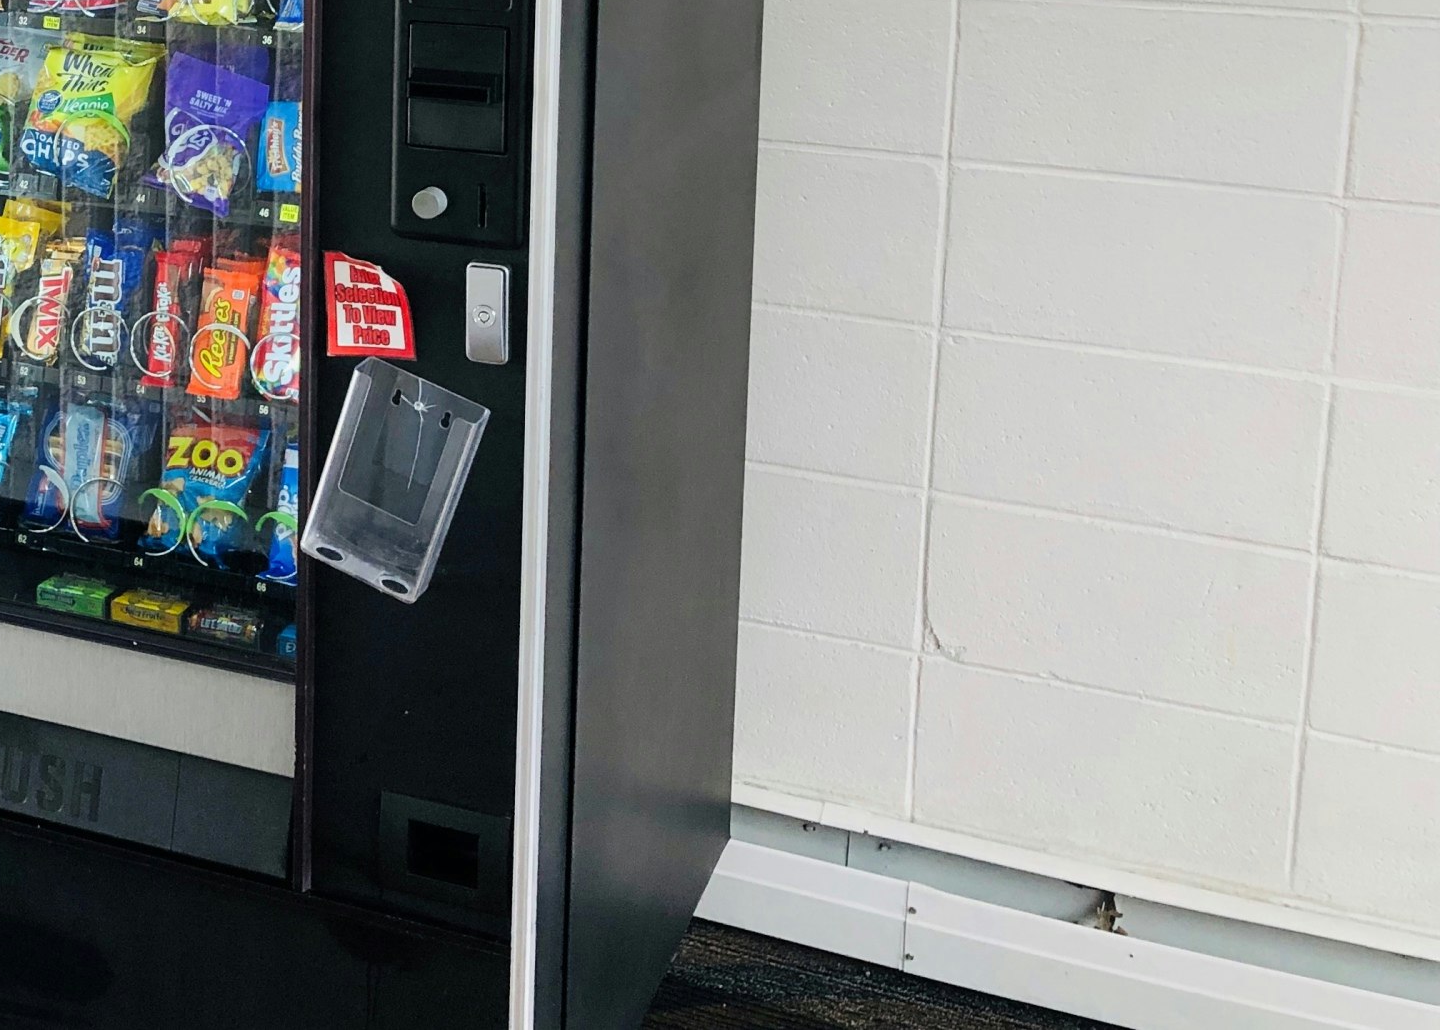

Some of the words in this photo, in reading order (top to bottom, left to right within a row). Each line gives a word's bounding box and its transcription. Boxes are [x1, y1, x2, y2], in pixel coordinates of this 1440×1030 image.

[18, 16, 28, 25] 32
[136, 25, 147, 35] 34
[262, 35, 272, 45] 36
[63, 51, 118, 79] Wheat
[56, 72, 110, 93] Thins
[196, 89, 222, 106] SWEET
[62, 97, 110, 118] Veggie
[189, 97, 213, 111] SALTY
[213, 102, 229, 114] MIX
[35, 131, 80, 150] TOATED
[19, 180, 29, 189] 42
[136, 193, 146, 203] 44
[259, 208, 270, 217] 46
[281, 205, 298, 213] VALUE
[282, 211, 296, 220] ITEM
[335, 283, 401, 307] Selection
[37, 266, 74, 350] TWIX
[342, 303, 361, 324] To
[361, 304, 397, 326] View
[263, 266, 300, 386] Skittles
[352, 324, 391, 346] Price
[19, 366, 29, 375] 52
[77, 375, 86, 385] 53
[259, 404, 269, 415] 56
[166, 435, 245, 476] ZOO
[189, 467, 227, 482] ANIMAL
[17, 533, 27, 544] 62
[256, 582, 266, 592] 66
